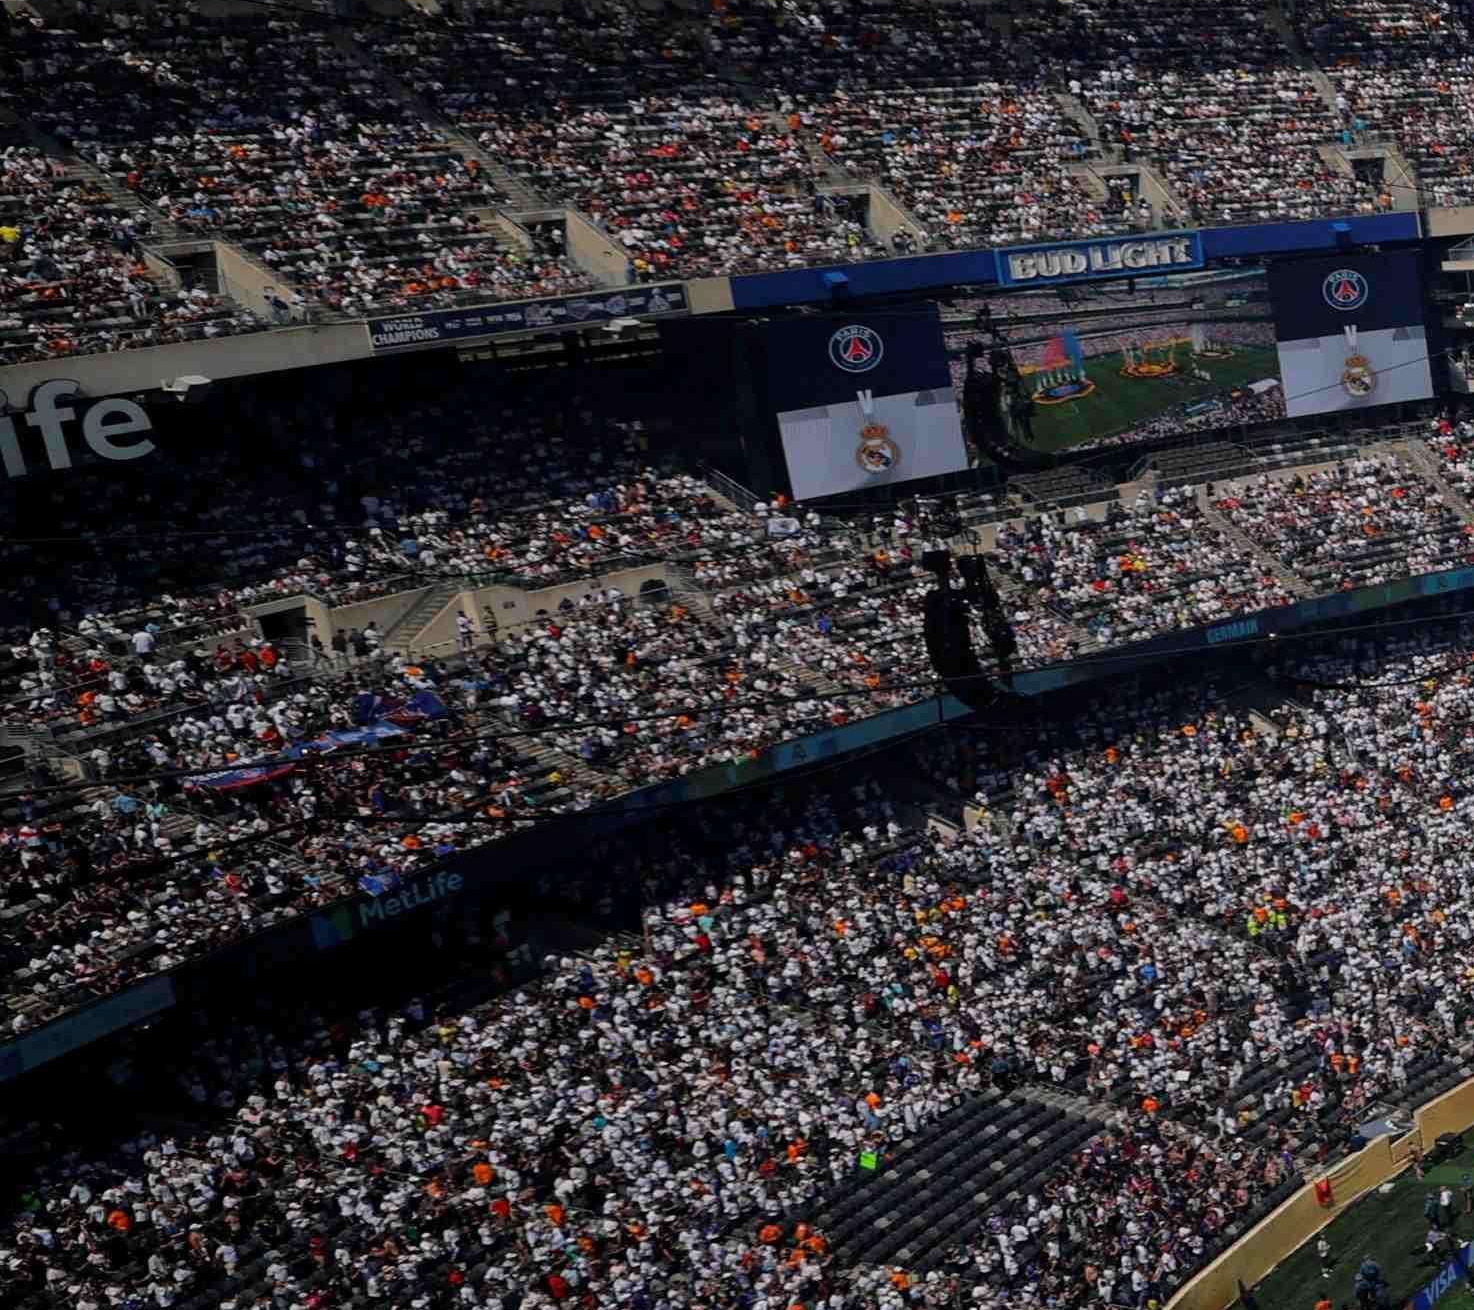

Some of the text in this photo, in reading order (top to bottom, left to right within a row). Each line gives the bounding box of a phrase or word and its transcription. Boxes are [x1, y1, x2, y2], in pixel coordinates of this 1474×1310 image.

[1008, 236, 1192, 281] BUD LIGHT
[373, 327, 440, 346] CHAMPIONS
[383, 316, 423, 332] WORLD
[359, 869, 465, 929] MetLife
